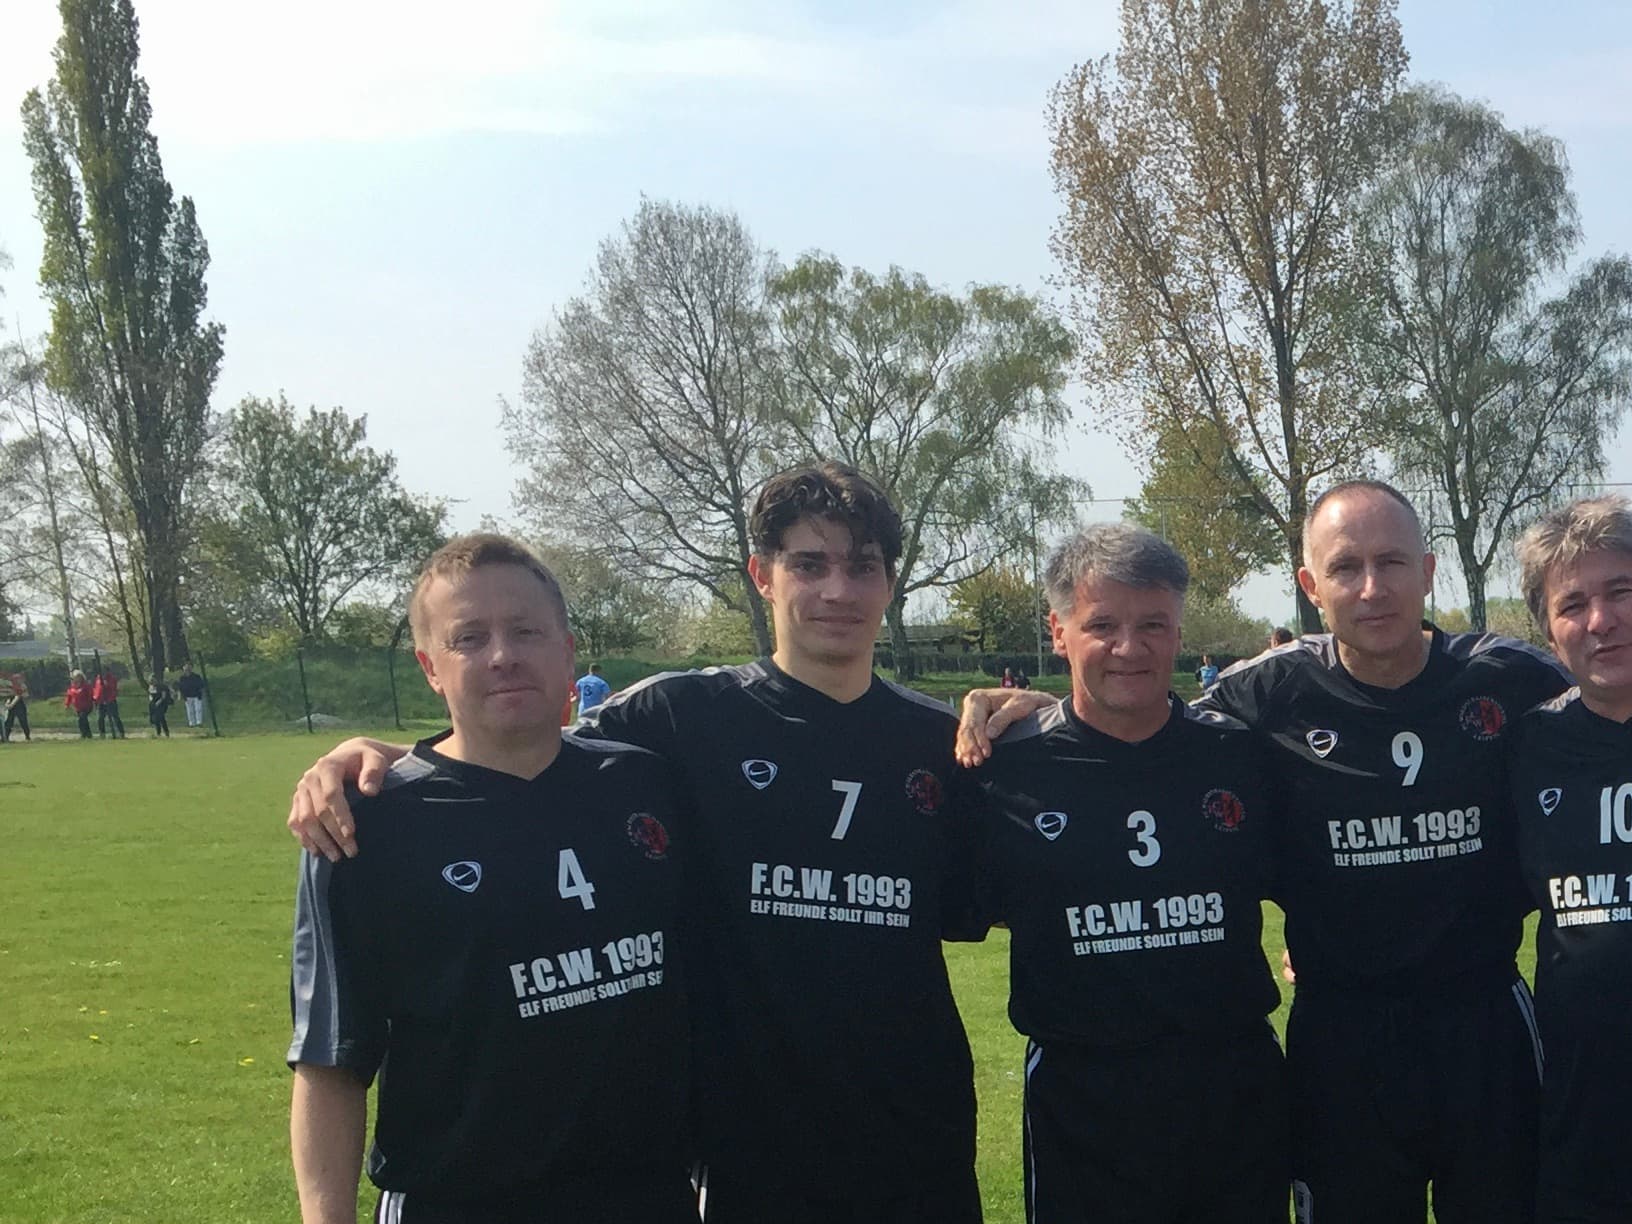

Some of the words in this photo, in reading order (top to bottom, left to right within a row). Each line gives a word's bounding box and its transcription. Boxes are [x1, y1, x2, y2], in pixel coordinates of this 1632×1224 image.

[1391, 731, 1424, 787] 9
[831, 779, 862, 840] 7
[1328, 815, 1409, 849] F.C.W.
[1412, 806, 1481, 842] 1993
[1127, 810, 1160, 867] 3
[1351, 850, 1402, 866] FREUNDE
[1403, 846, 1436, 862] SOLLT
[1437, 843, 1457, 858] IHR
[1459, 838, 1483, 854] SEIN
[557, 848, 595, 910] 4
[751, 862, 837, 902] F.C.W.
[843, 873, 912, 910] 1993
[1549, 873, 1620, 909] F.C.W.
[750, 900, 771, 914] ELF
[772, 901, 827, 920] FREUNDE
[829, 907, 862, 923] SOLLT
[864, 911, 884, 925] IHR
[886, 912, 910, 928] SEIN
[1065, 900, 1149, 937] F.C.W.
[1152, 892, 1224, 929] 1993
[1566, 909, 1610, 926] FREUNDE
[1073, 941, 1091, 956] ELF
[1092, 936, 1143, 954] FREUNDE
[1143, 933, 1178, 949] SOLLT
[1179, 930, 1200, 945] IHR
[1201, 927, 1225, 943] SEIN
[509, 948, 602, 998] F.C.W.
[601, 931, 664, 975] 1993
[519, 1002, 542, 1018] ELF
[541, 987, 598, 1013] FREUNDE
